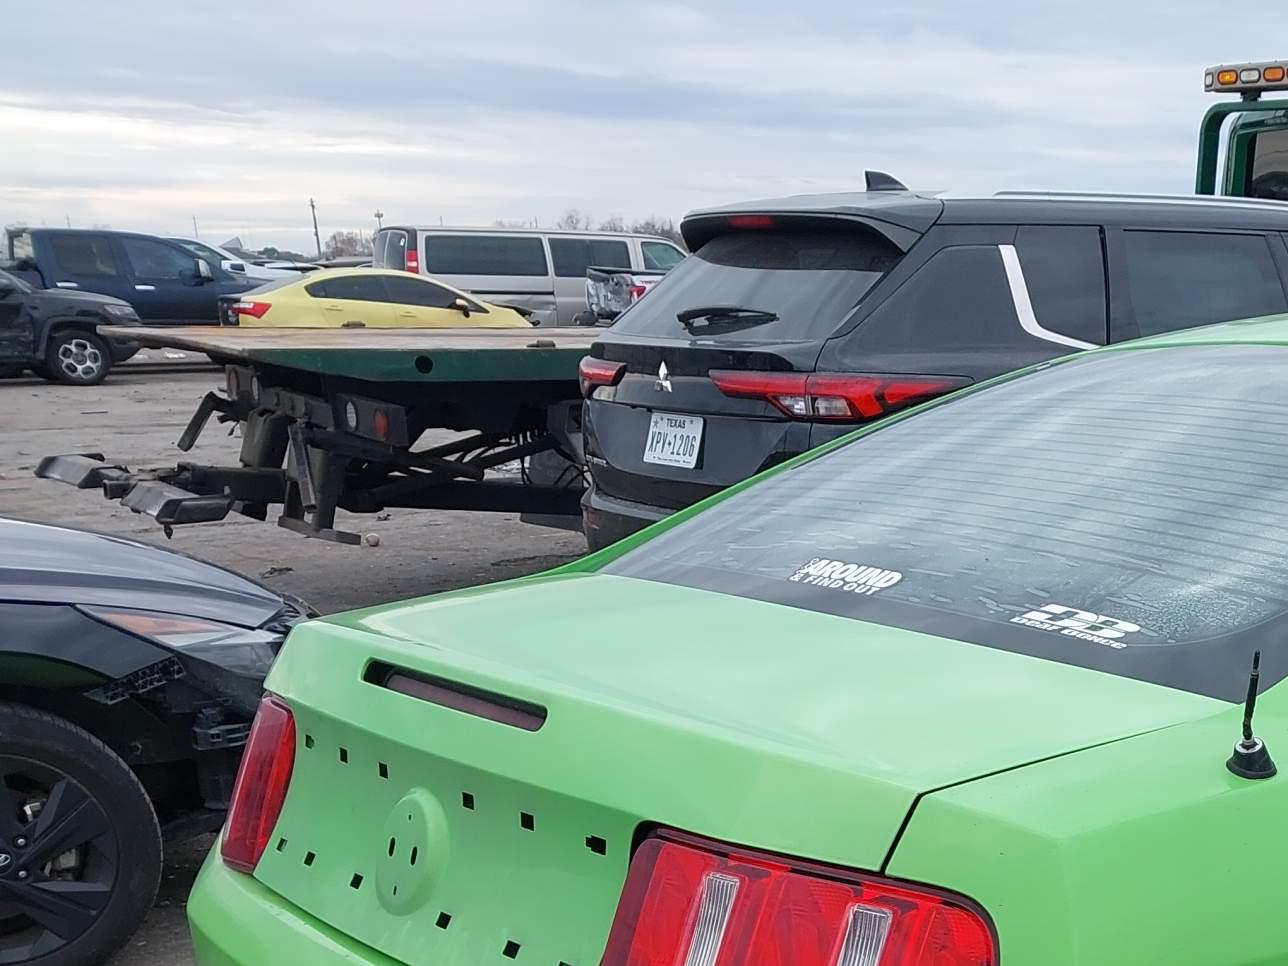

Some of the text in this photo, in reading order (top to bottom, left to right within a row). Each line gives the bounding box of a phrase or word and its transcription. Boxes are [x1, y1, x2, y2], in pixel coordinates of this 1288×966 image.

[666, 417, 686, 429] TEXAS
[806, 559, 903, 588] AROUND
[803, 575, 844, 588] FIND
[843, 582, 881, 596] OUT
